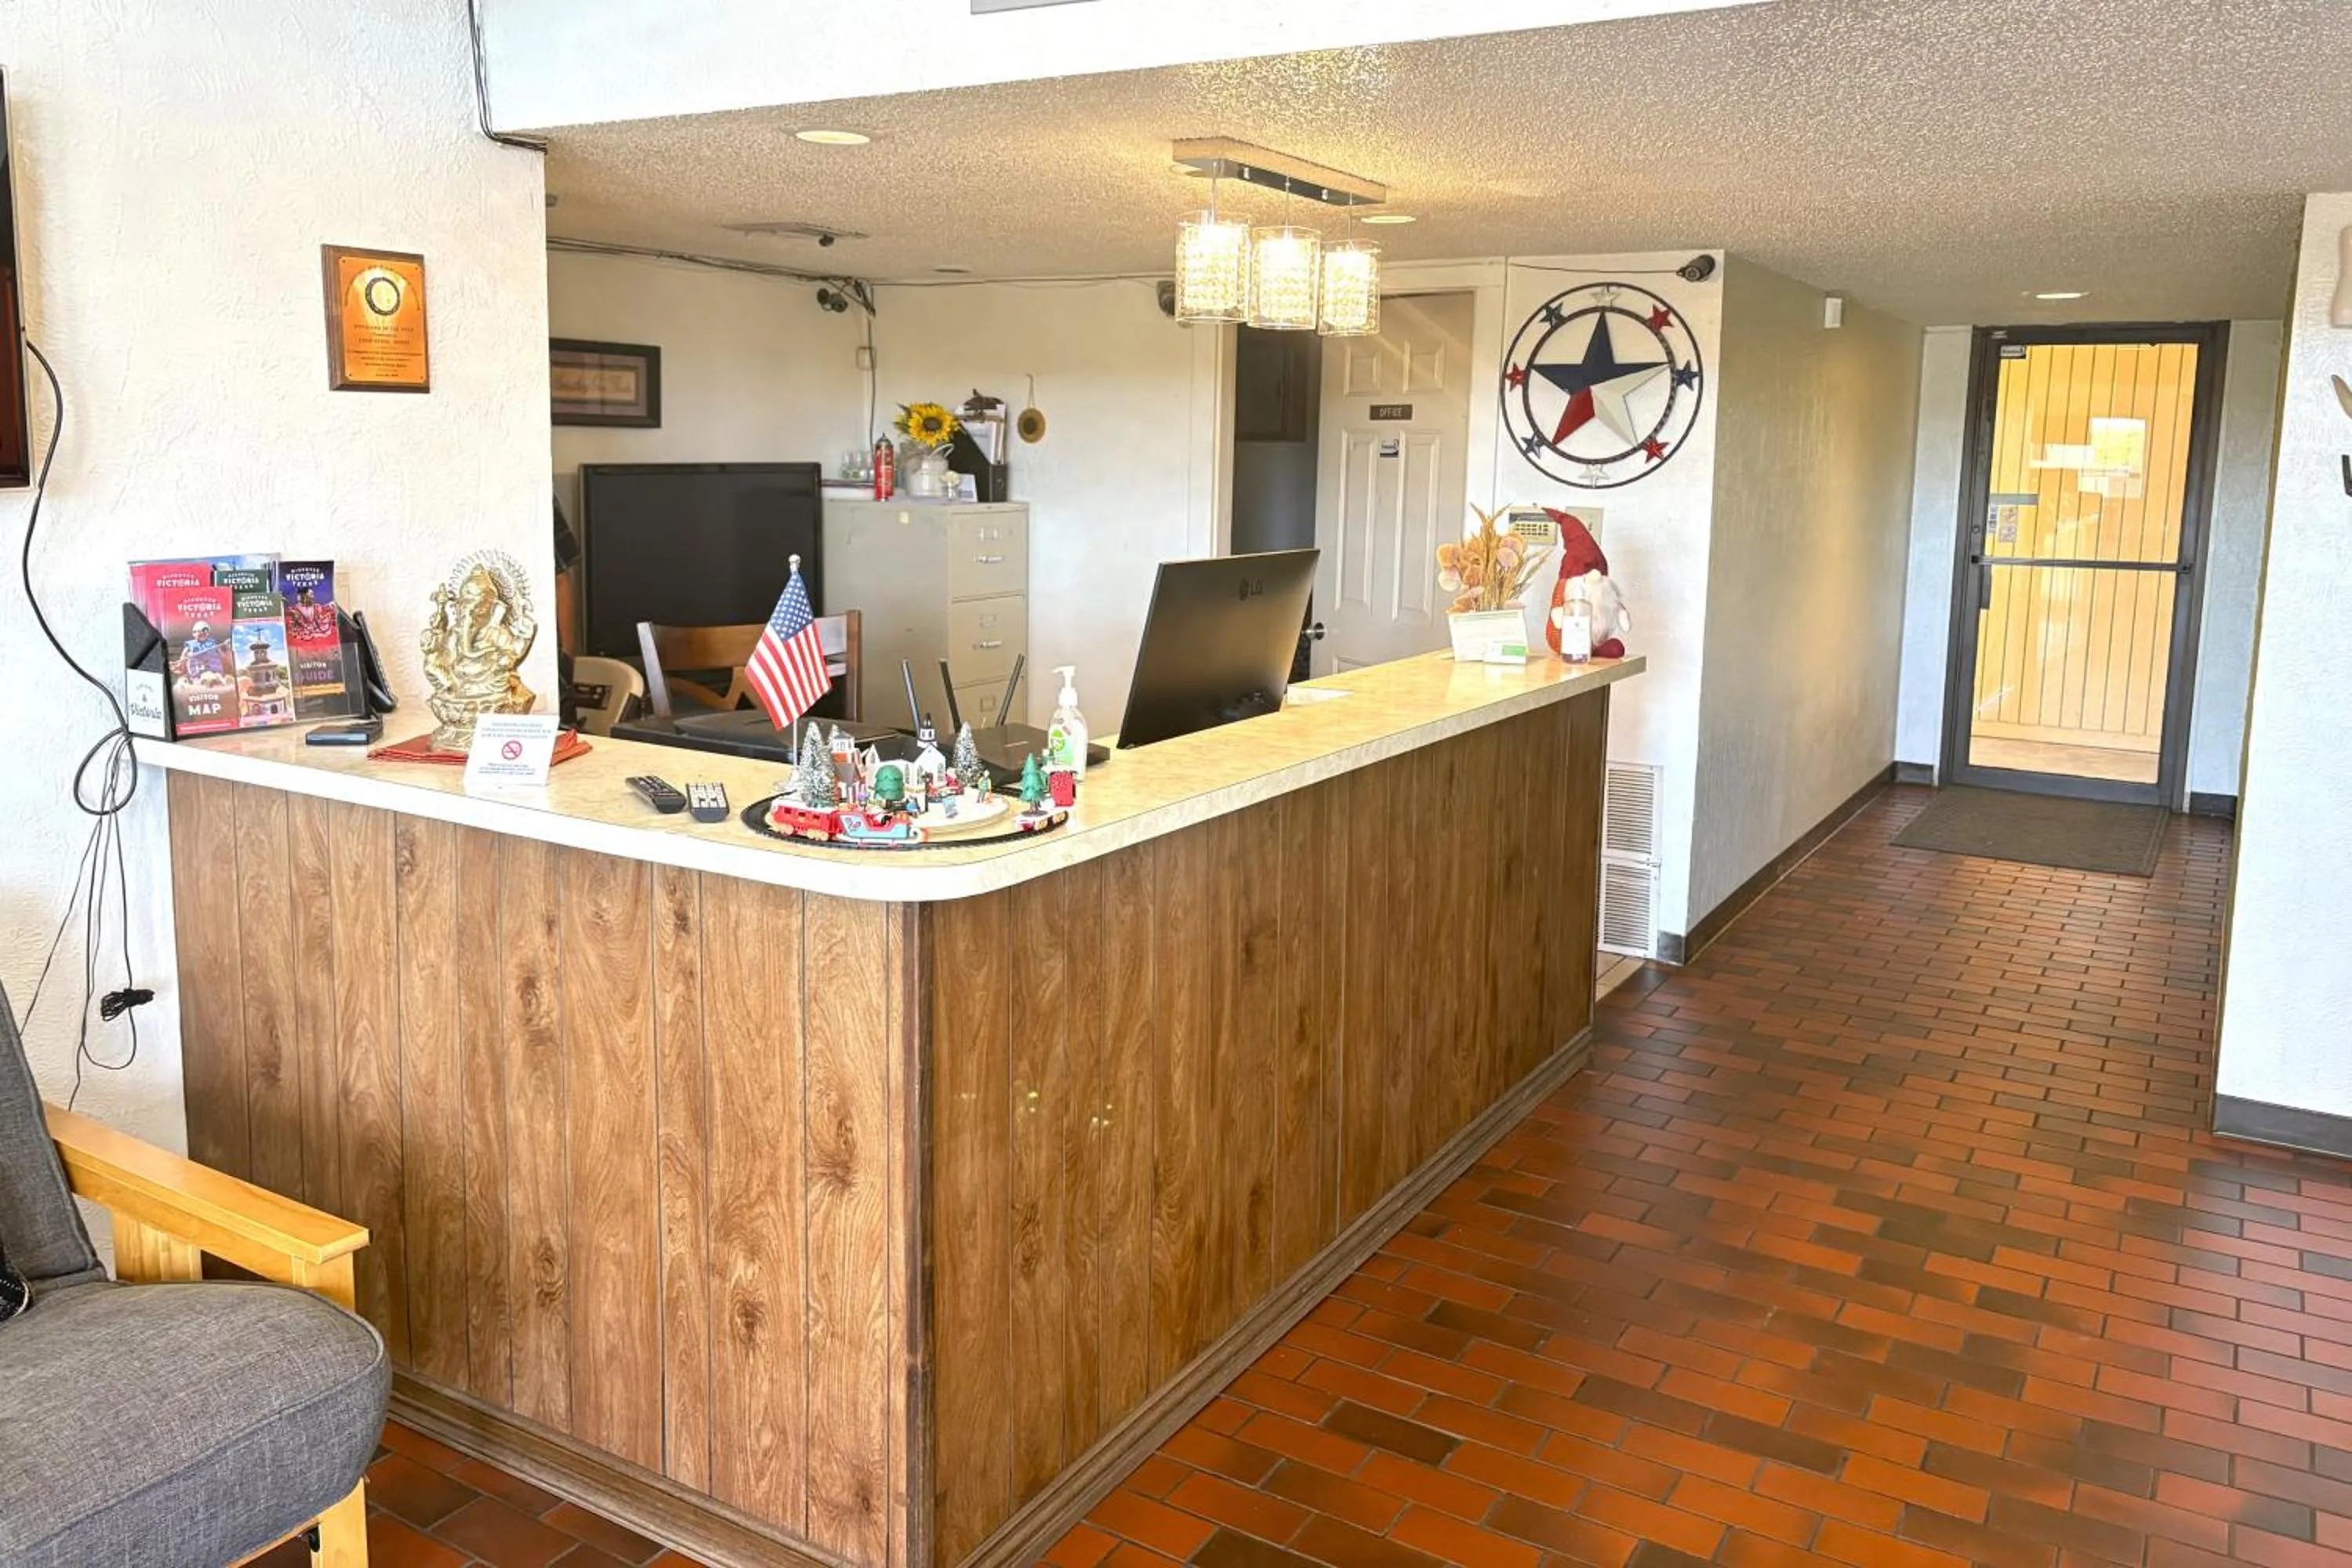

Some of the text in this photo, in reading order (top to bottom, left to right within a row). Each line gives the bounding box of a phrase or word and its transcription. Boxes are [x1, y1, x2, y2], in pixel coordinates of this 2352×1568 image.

[285, 572, 325, 581] VICTORIA
[157, 579, 200, 587] VICTORIA
[176, 603, 222, 612] VICTORIA
[188, 702, 221, 716] MAP
